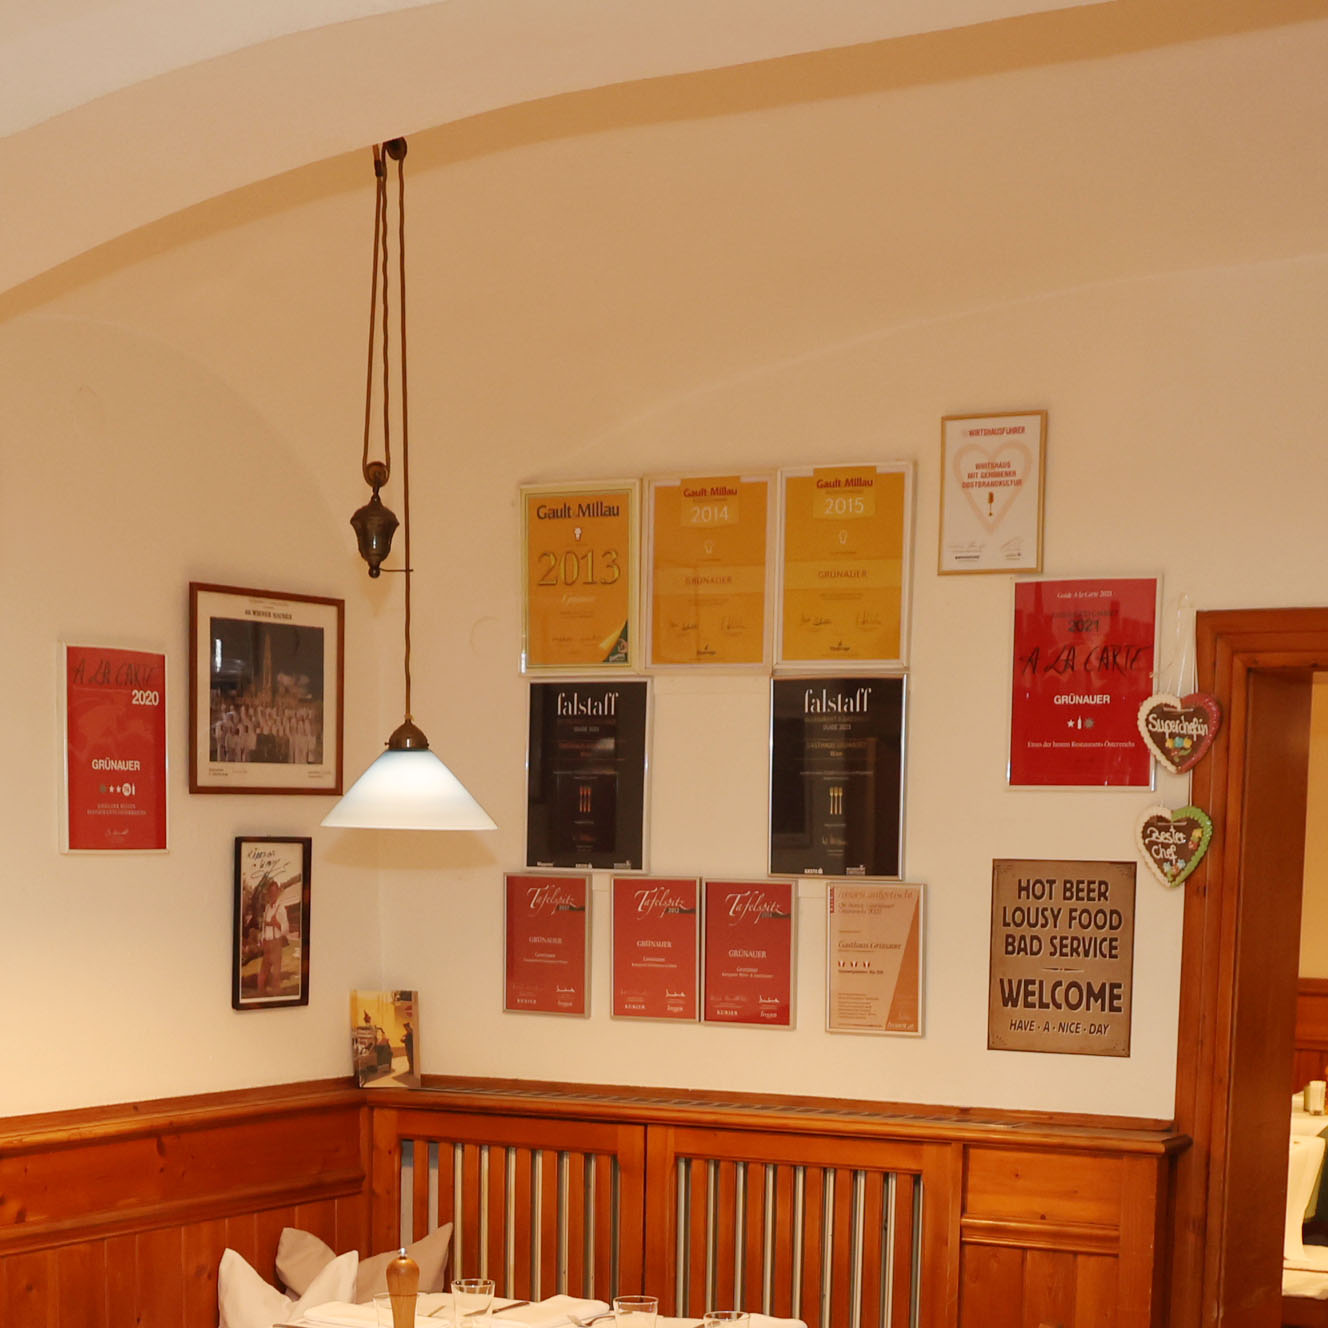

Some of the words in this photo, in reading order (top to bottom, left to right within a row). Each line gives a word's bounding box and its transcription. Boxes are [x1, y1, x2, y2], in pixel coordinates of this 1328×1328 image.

[690, 505, 729, 523] 2014
[824, 496, 865, 515] 2015
[537, 549, 621, 586] 2013
[1068, 619, 1100, 633] 2021
[131, 689, 160, 706] 2020
[557, 691, 620, 717] falstaff
[804, 687, 872, 714] falstaff
[1053, 693, 1111, 705] GRÜNAUER
[1148, 713, 1209, 741] Superchefin
[91, 757, 141, 772] GRÜNAUER
[1145, 825, 1187, 844] Bester
[1151, 845, 1177, 864] Chef
[1017, 878, 1057, 901] HOT
[1062, 879, 1110, 902] BEER
[634, 887, 688, 920] Tafelspitz
[725, 890, 785, 926] Tafelspitz
[1002, 906, 1062, 930] LOUSY
[1068, 908, 1123, 931] FOOD
[1004, 933, 1043, 957] BAD
[1049, 935, 1119, 959] SERVICE
[999, 978, 1123, 1013] WELCOME
[1009, 1019, 1035, 1032] HAVE
[1042, 1020, 1050, 1033] A
[1057, 1021, 1082, 1034] NICE
[1088, 1023, 1110, 1036] DAY
